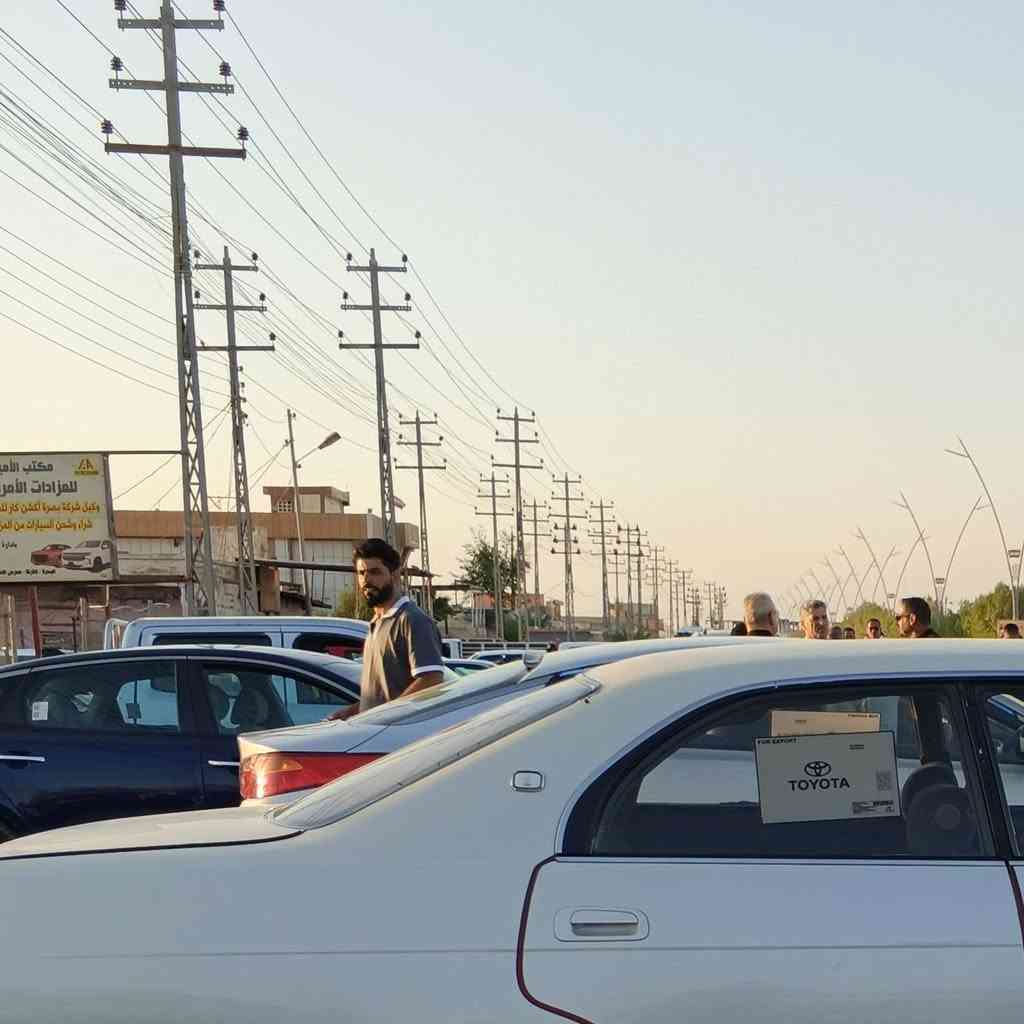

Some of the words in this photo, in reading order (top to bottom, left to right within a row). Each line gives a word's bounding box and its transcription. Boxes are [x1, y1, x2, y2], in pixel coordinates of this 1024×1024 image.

[0, 457, 20, 475] الأمي
[22, 459, 54, 475] مكتب
[0, 478, 27, 497] الأمر
[31, 479, 78, 496] للمزادات
[787, 777, 850, 791] TOYOTA
